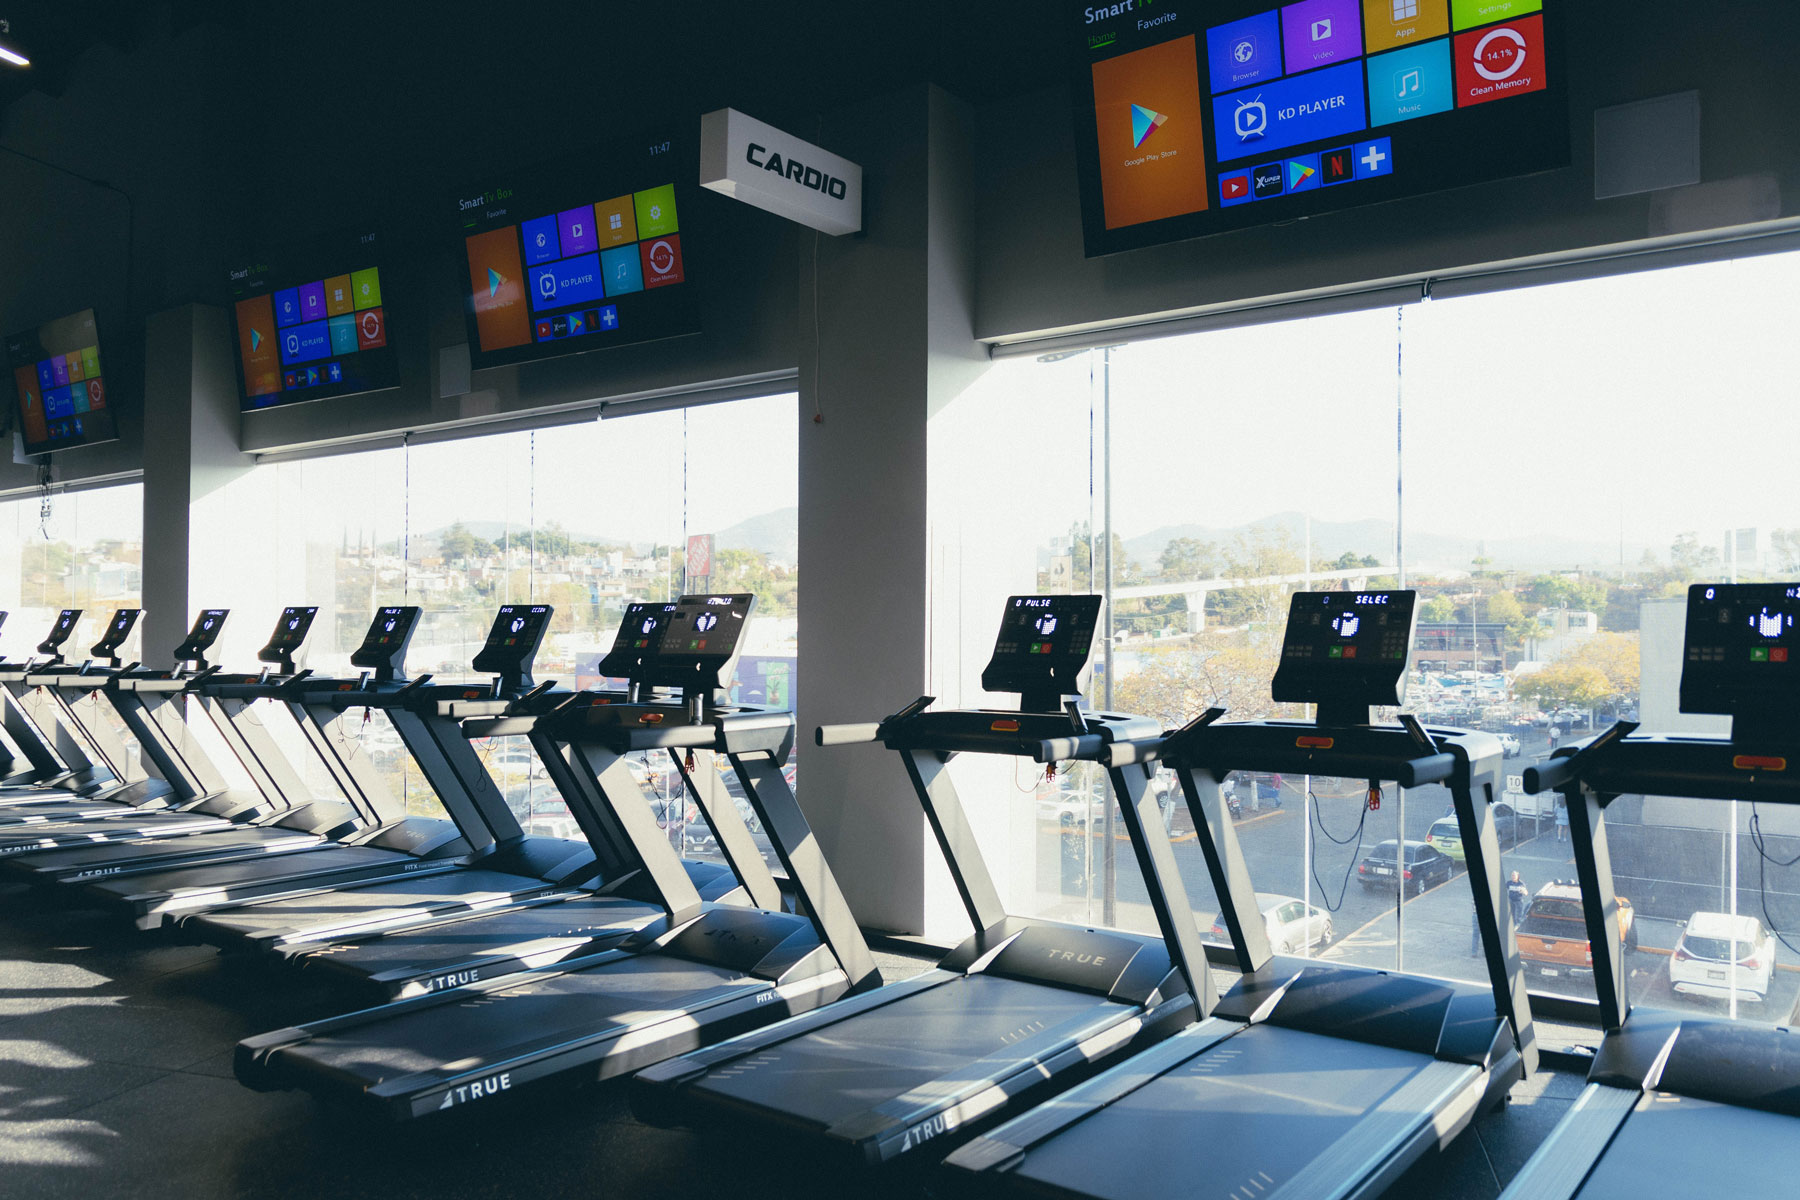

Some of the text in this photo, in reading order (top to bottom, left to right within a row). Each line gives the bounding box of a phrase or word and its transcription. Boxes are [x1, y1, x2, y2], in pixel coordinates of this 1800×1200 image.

[1085, 0, 1134, 25] Smart
[1138, 13, 1177, 31] Favorite
[1088, 32, 1117, 46] Home
[1395, 29, 1416, 38] Apps
[1313, 50, 1335, 61] Video
[1487, 49, 1513, 61] 14.1%
[1232, 70, 1260, 82] Browser
[1470, 77, 1532, 97] Clean Memory
[1278, 95, 1347, 121] KD PLAYER
[1398, 104, 1422, 115] Music
[649, 141, 671, 156] 11:47
[1124, 157, 1145, 167] Google
[1146, 154, 1160, 162] Play
[746, 142, 847, 201] CARDIO
[459, 195, 485, 211] Smart
[497, 188, 513, 201] Box
[560, 274, 593, 288] KD PLAYER
[1025, 599, 1051, 607] PULSE
[1355, 595, 1389, 604] SELEC
[1510, 777, 1521, 787] 10
[1049, 949, 1106, 967] TRUE
[435, 970, 479, 990] TRUE
[756, 991, 773, 1004] FITX
[456, 1073, 512, 1104] TRUE
